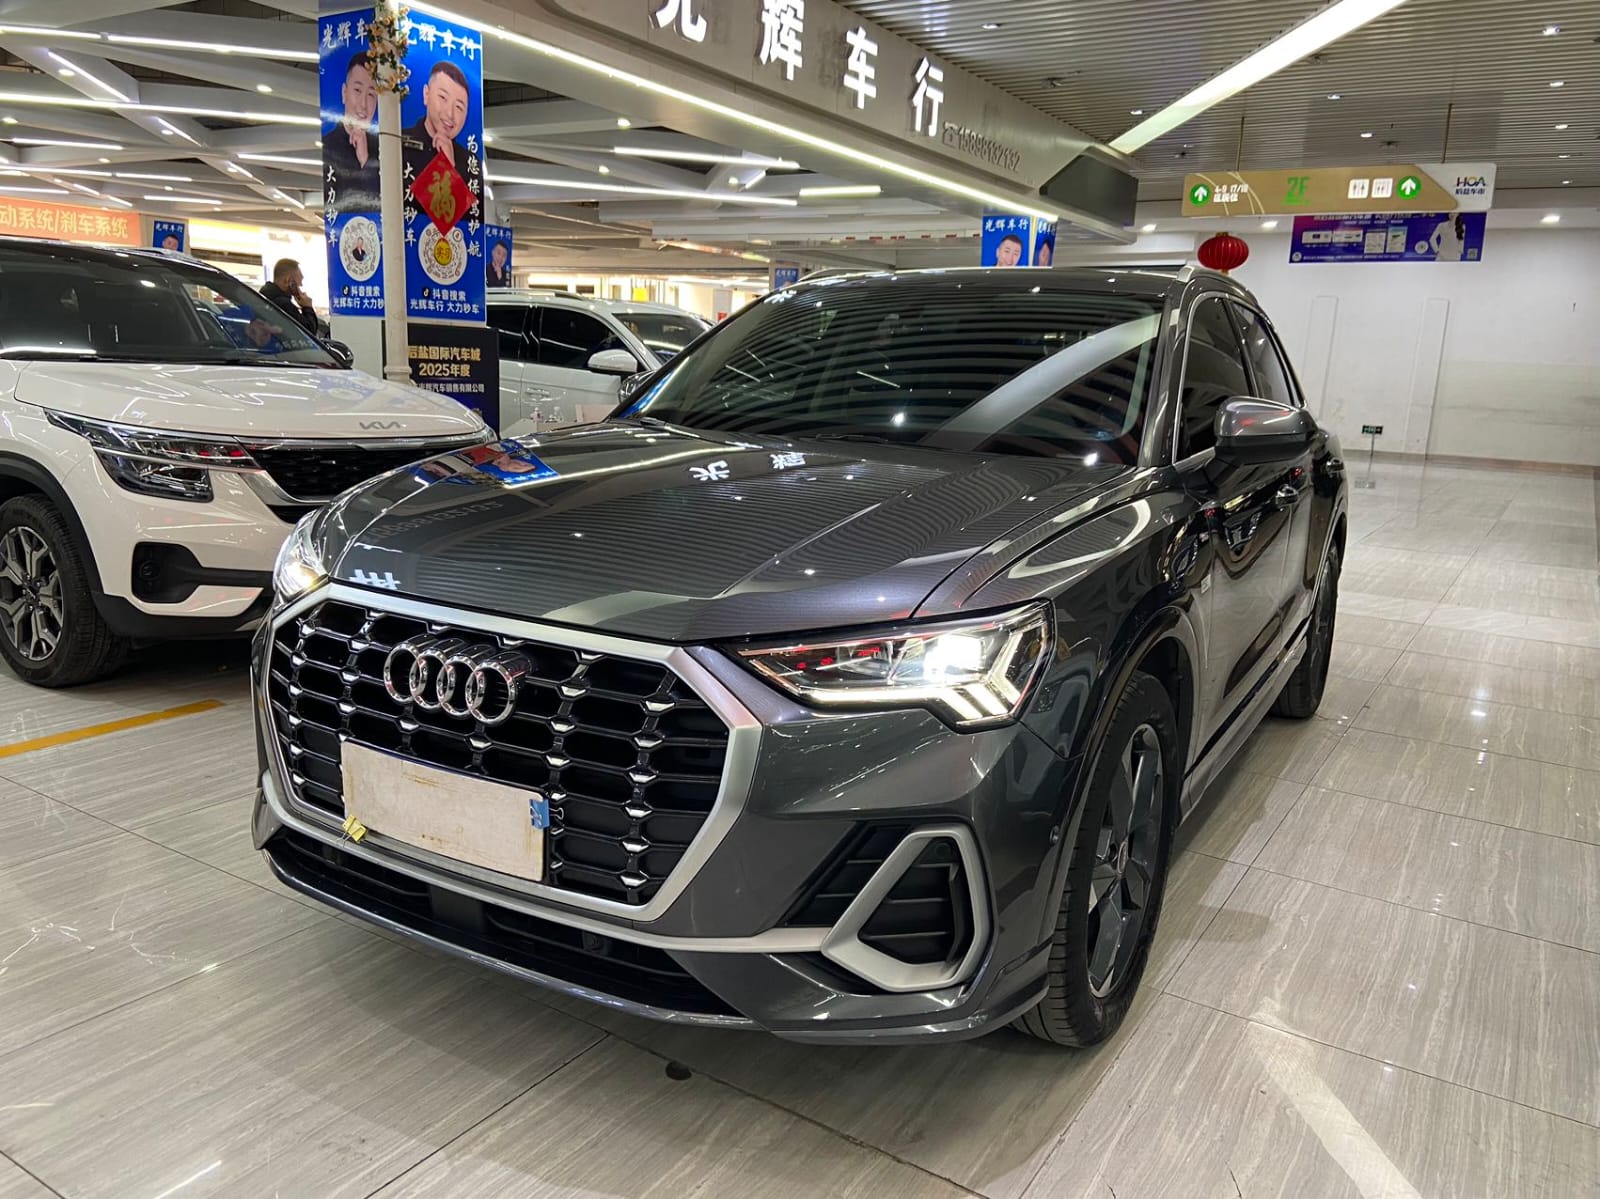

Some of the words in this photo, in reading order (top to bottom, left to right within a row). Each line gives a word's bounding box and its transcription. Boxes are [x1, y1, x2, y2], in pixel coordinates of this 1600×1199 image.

[322, 17, 375, 49] 光辉车
[432, 288, 466, 302] 抖音搜索
[333, 297, 361, 309] 光辉车行
[410, 298, 444, 312] 光辉车行
[446, 301, 480, 315] 大力秒车
[419, 362, 471, 377] 2025年度
